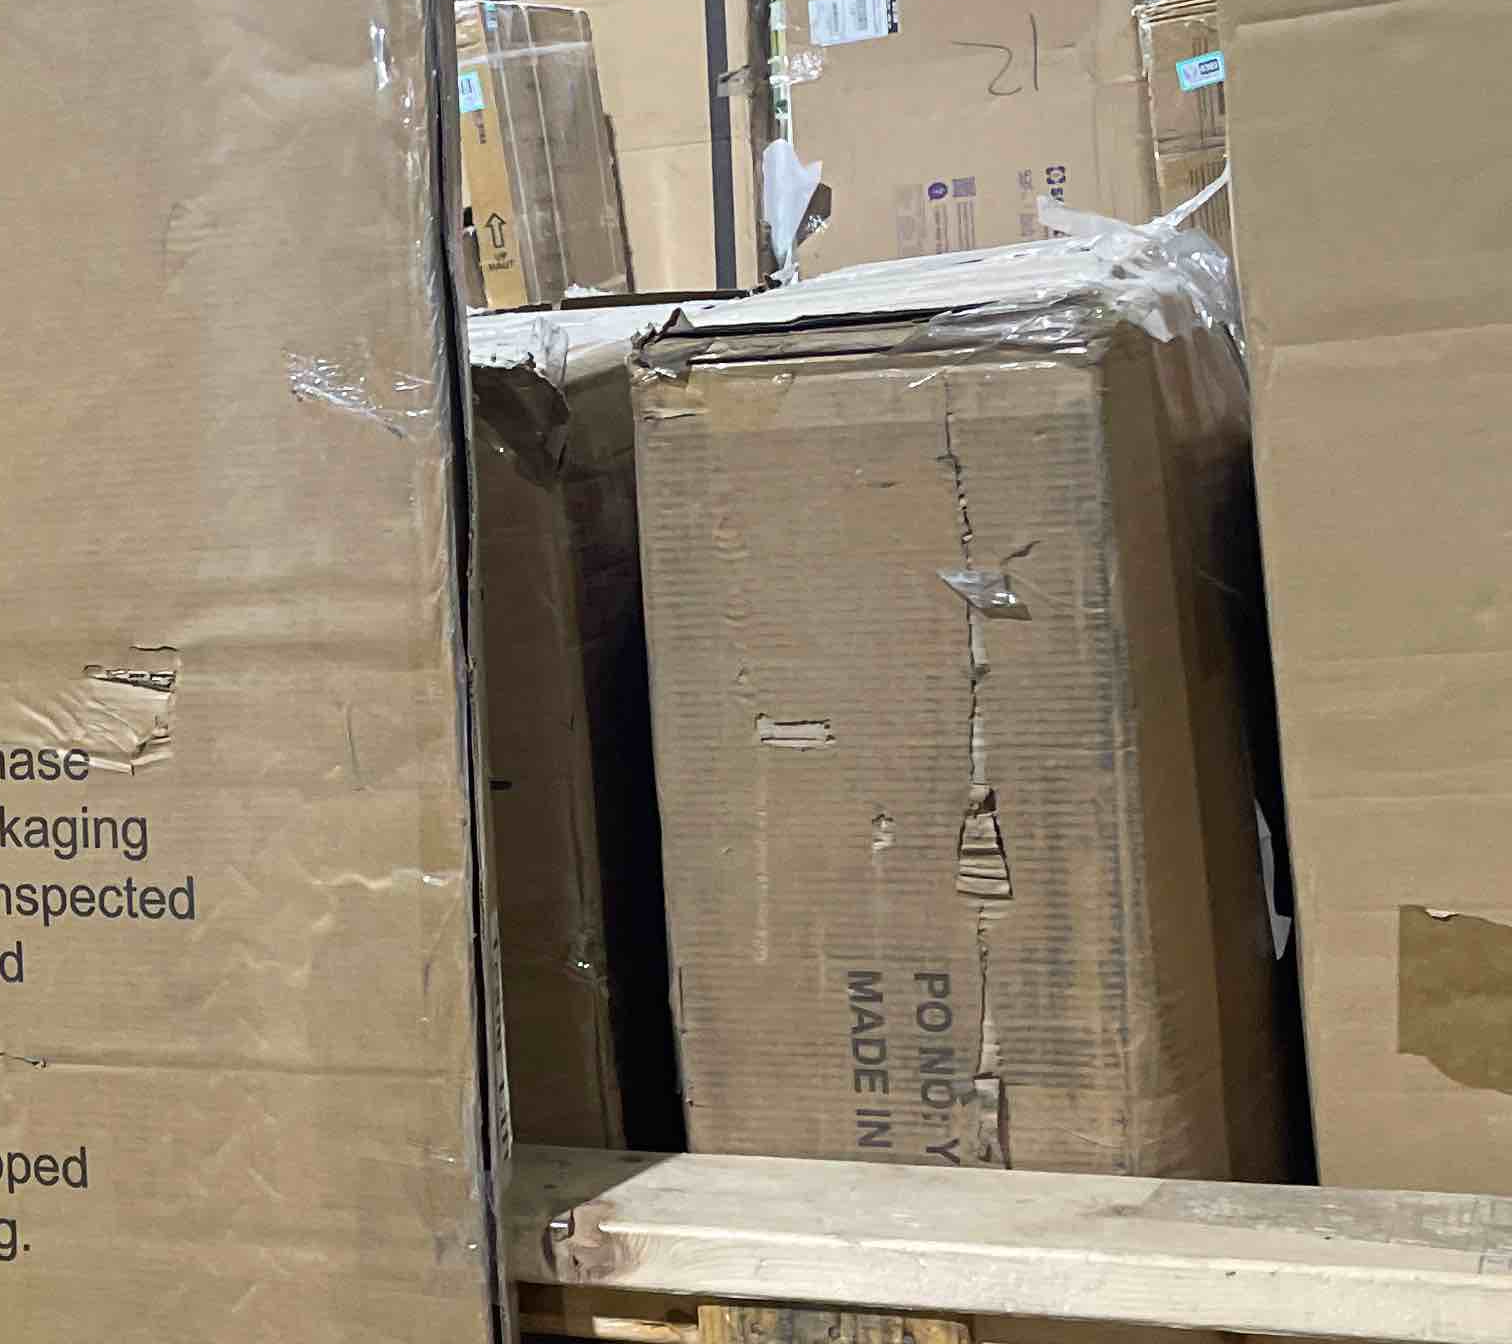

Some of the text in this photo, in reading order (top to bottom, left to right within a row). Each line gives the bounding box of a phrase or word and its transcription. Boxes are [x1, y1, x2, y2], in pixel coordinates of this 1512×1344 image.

[847, 971, 892, 1148] MADE IN
[914, 973, 952, 1033] PO
